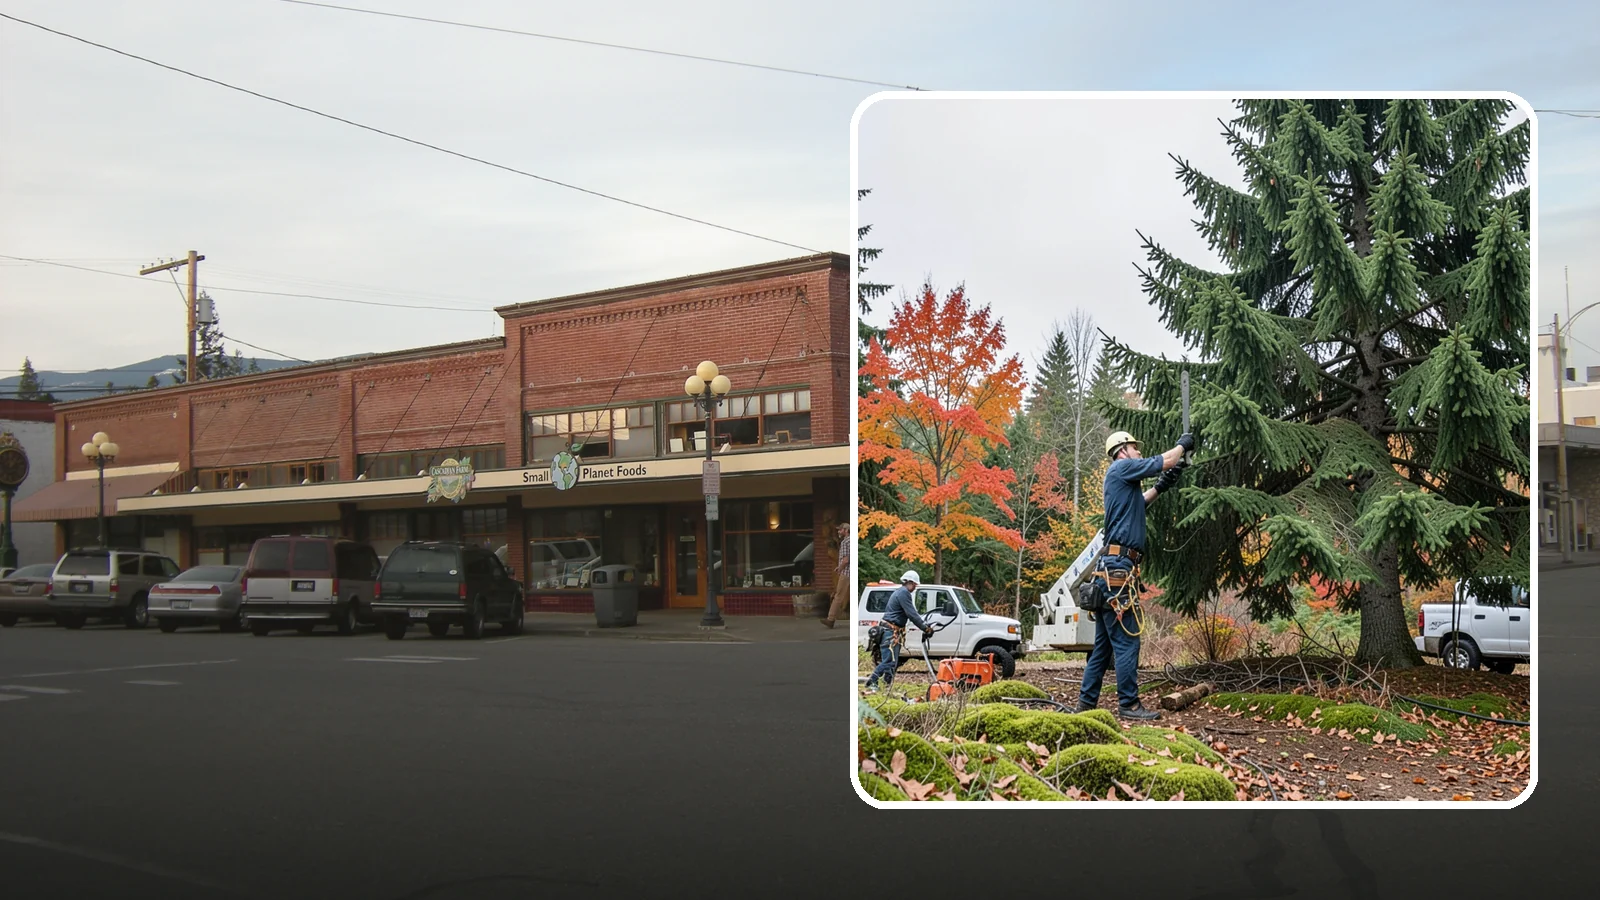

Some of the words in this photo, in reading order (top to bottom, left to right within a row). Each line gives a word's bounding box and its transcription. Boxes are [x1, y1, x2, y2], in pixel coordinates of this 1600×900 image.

[523, 471, 549, 483] Small
[582, 467, 614, 479] Planet
[616, 464, 647, 477] Foods
